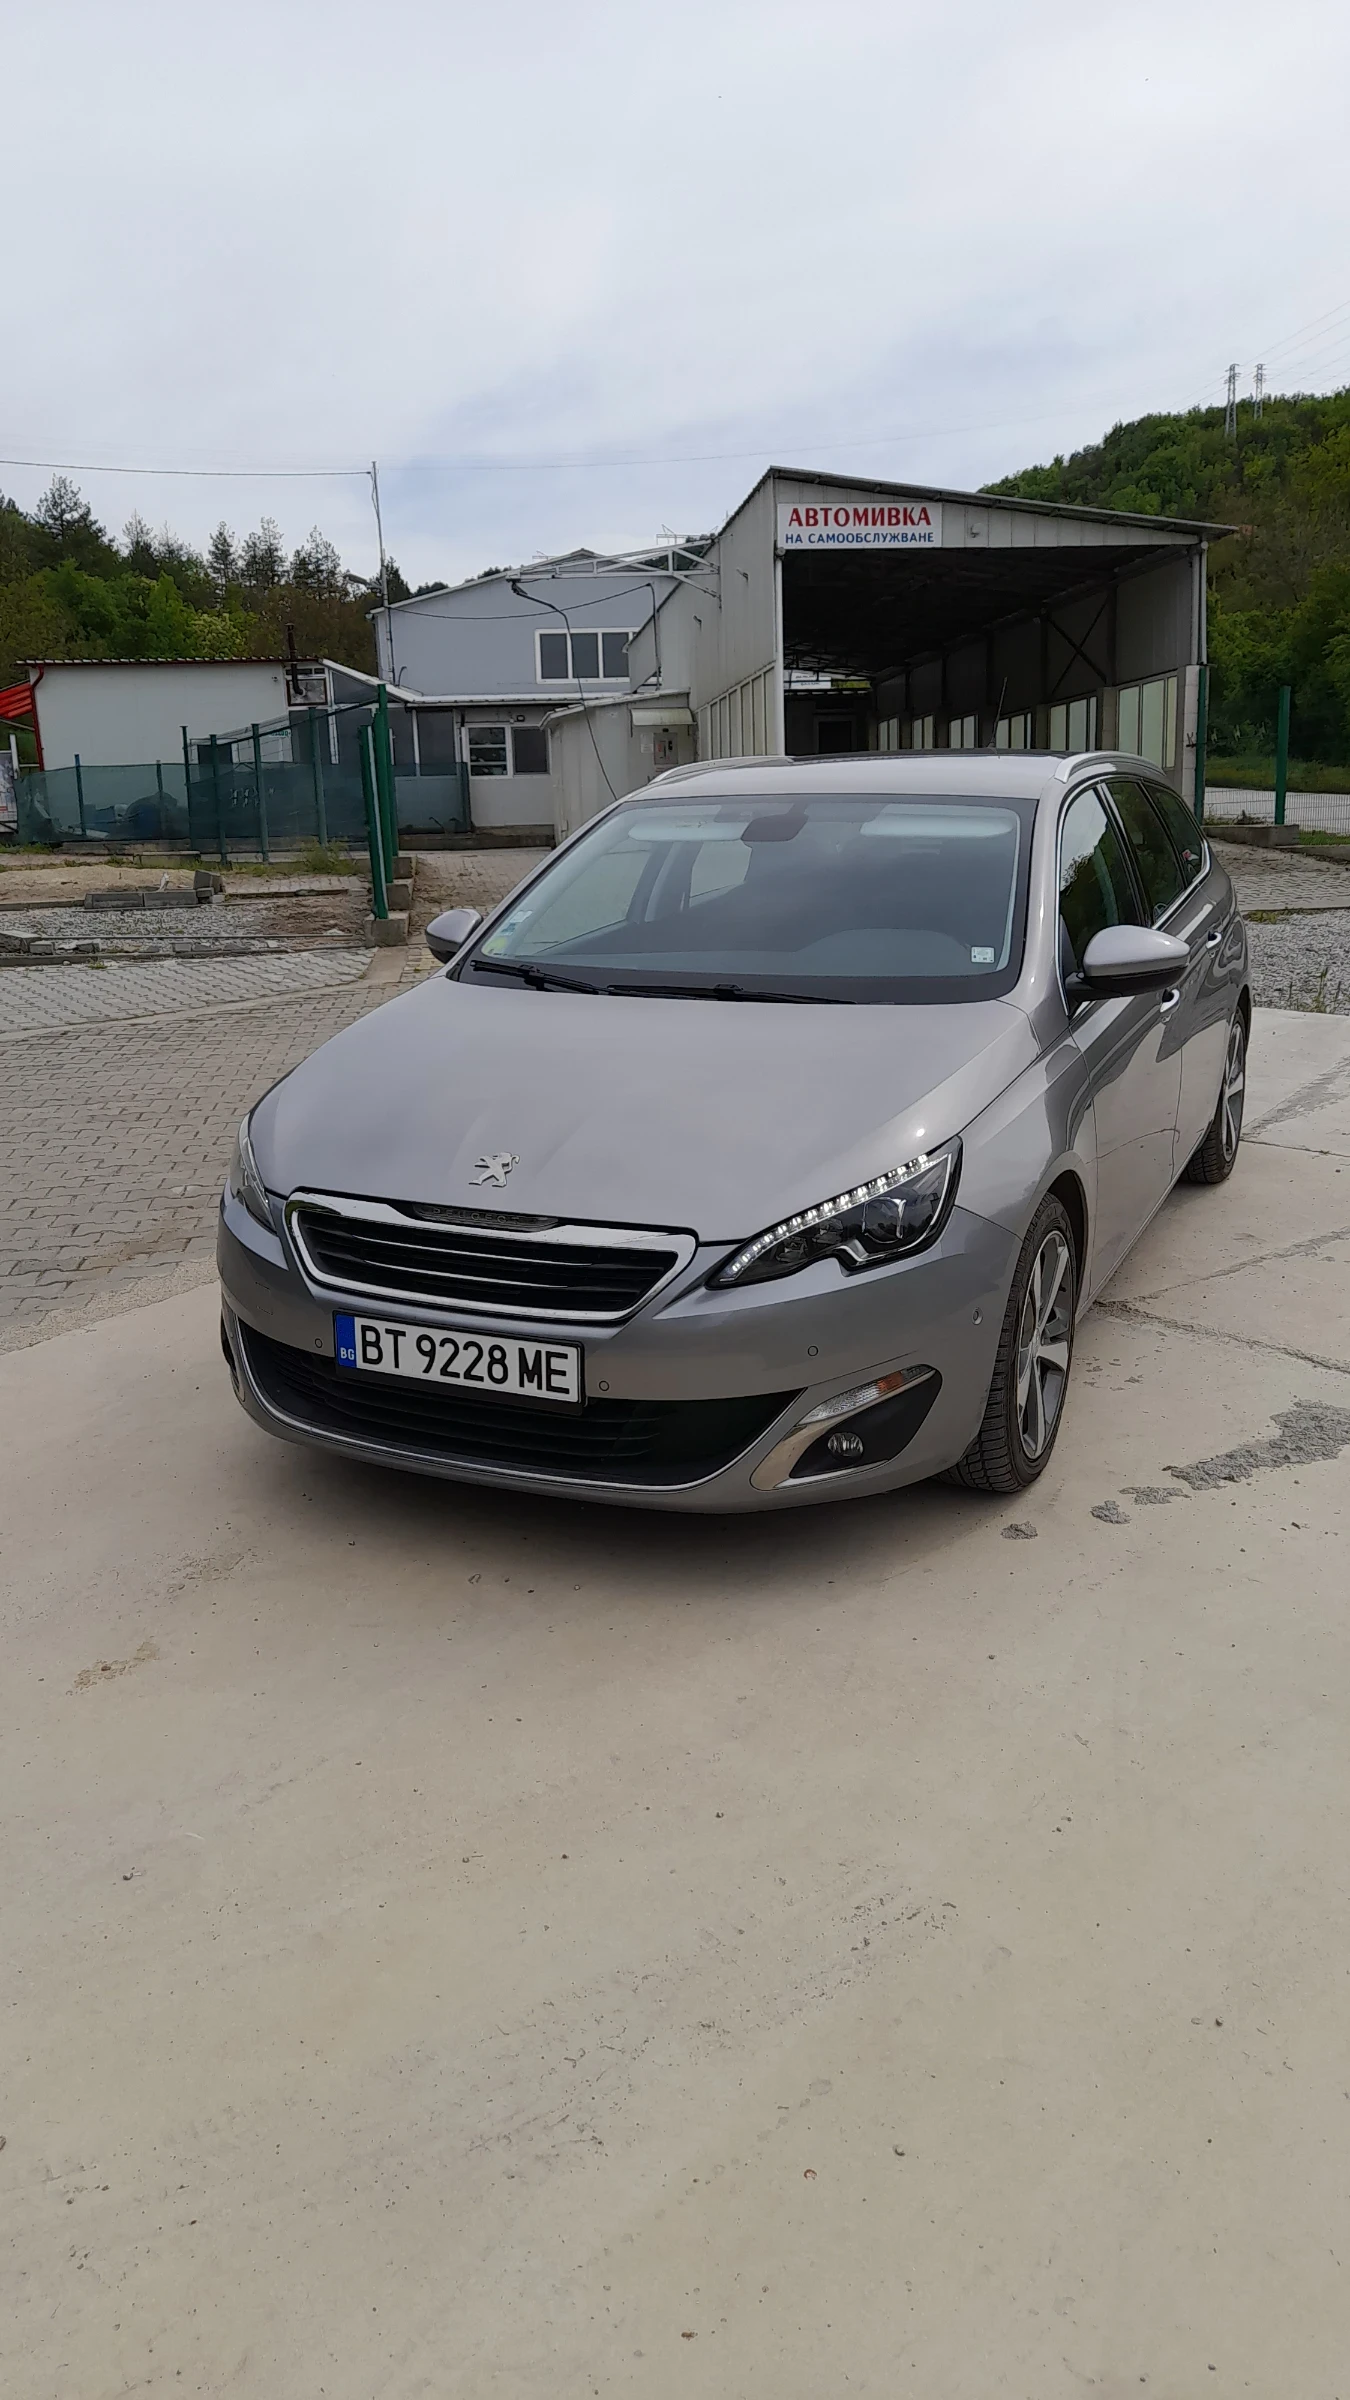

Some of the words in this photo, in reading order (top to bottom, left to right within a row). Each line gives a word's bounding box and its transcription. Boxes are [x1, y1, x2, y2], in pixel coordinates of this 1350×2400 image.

[788, 507, 931, 527] АВТОМИВКА
[785, 533, 803, 544] НА
[808, 532, 935, 544] САМООБСЛУЖВАНЕ
[433, 1208, 520, 1224] PEUGEOT
[340, 1347, 355, 1361] BG
[360, 1324, 407, 1369] BT
[415, 1334, 509, 1385] 9228
[518, 1347, 570, 1395] ME
